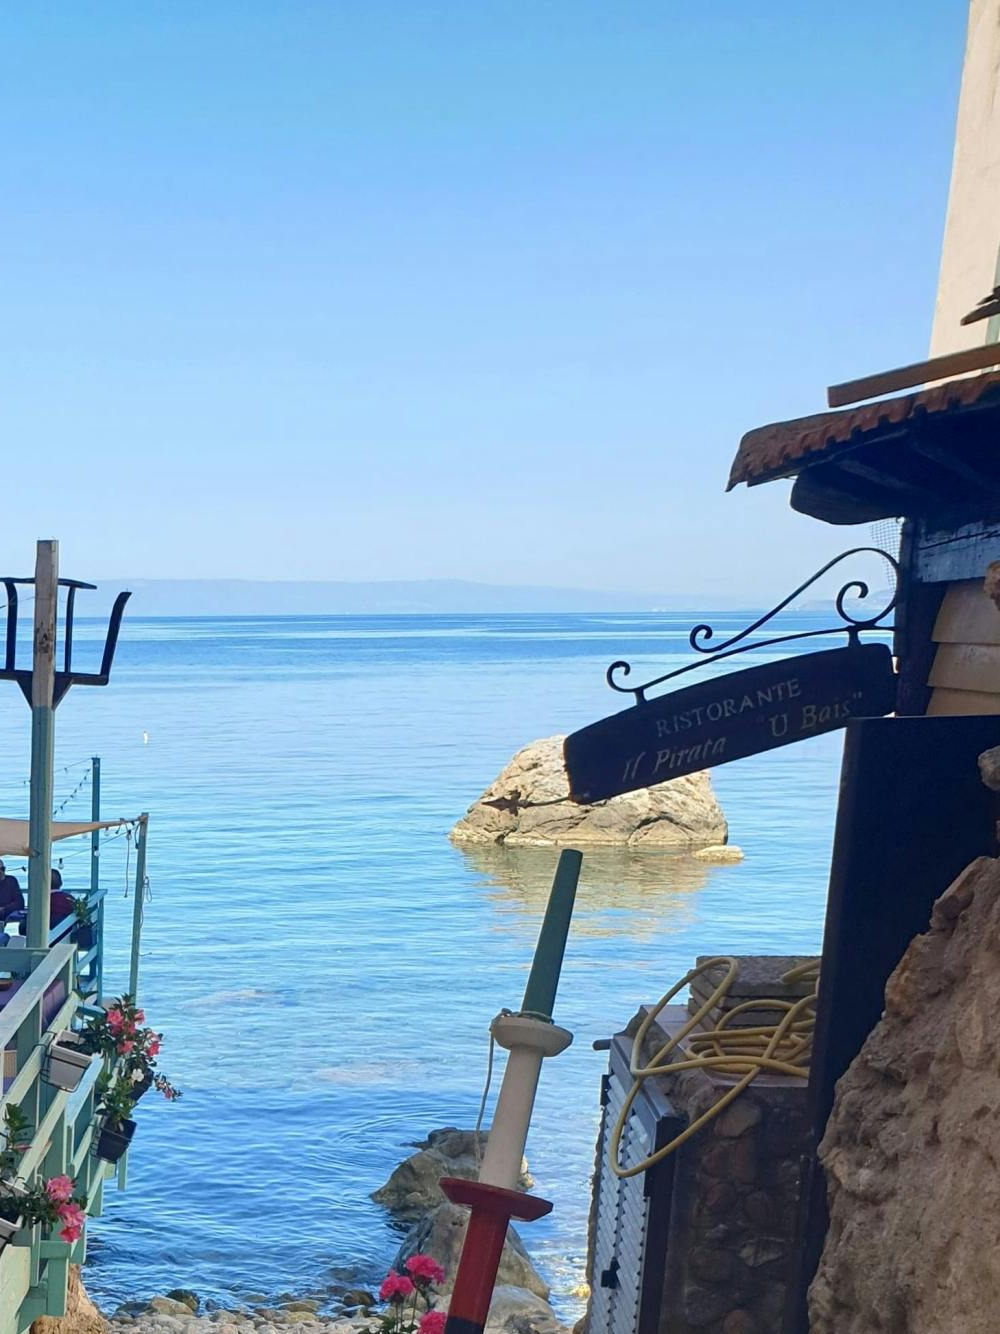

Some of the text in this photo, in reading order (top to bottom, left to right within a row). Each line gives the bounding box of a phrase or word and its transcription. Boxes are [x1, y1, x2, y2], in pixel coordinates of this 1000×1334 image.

[656, 678, 802, 737] RISTORANTE
[622, 751, 646, 782] Il
[652, 736, 728, 774] Pirata
